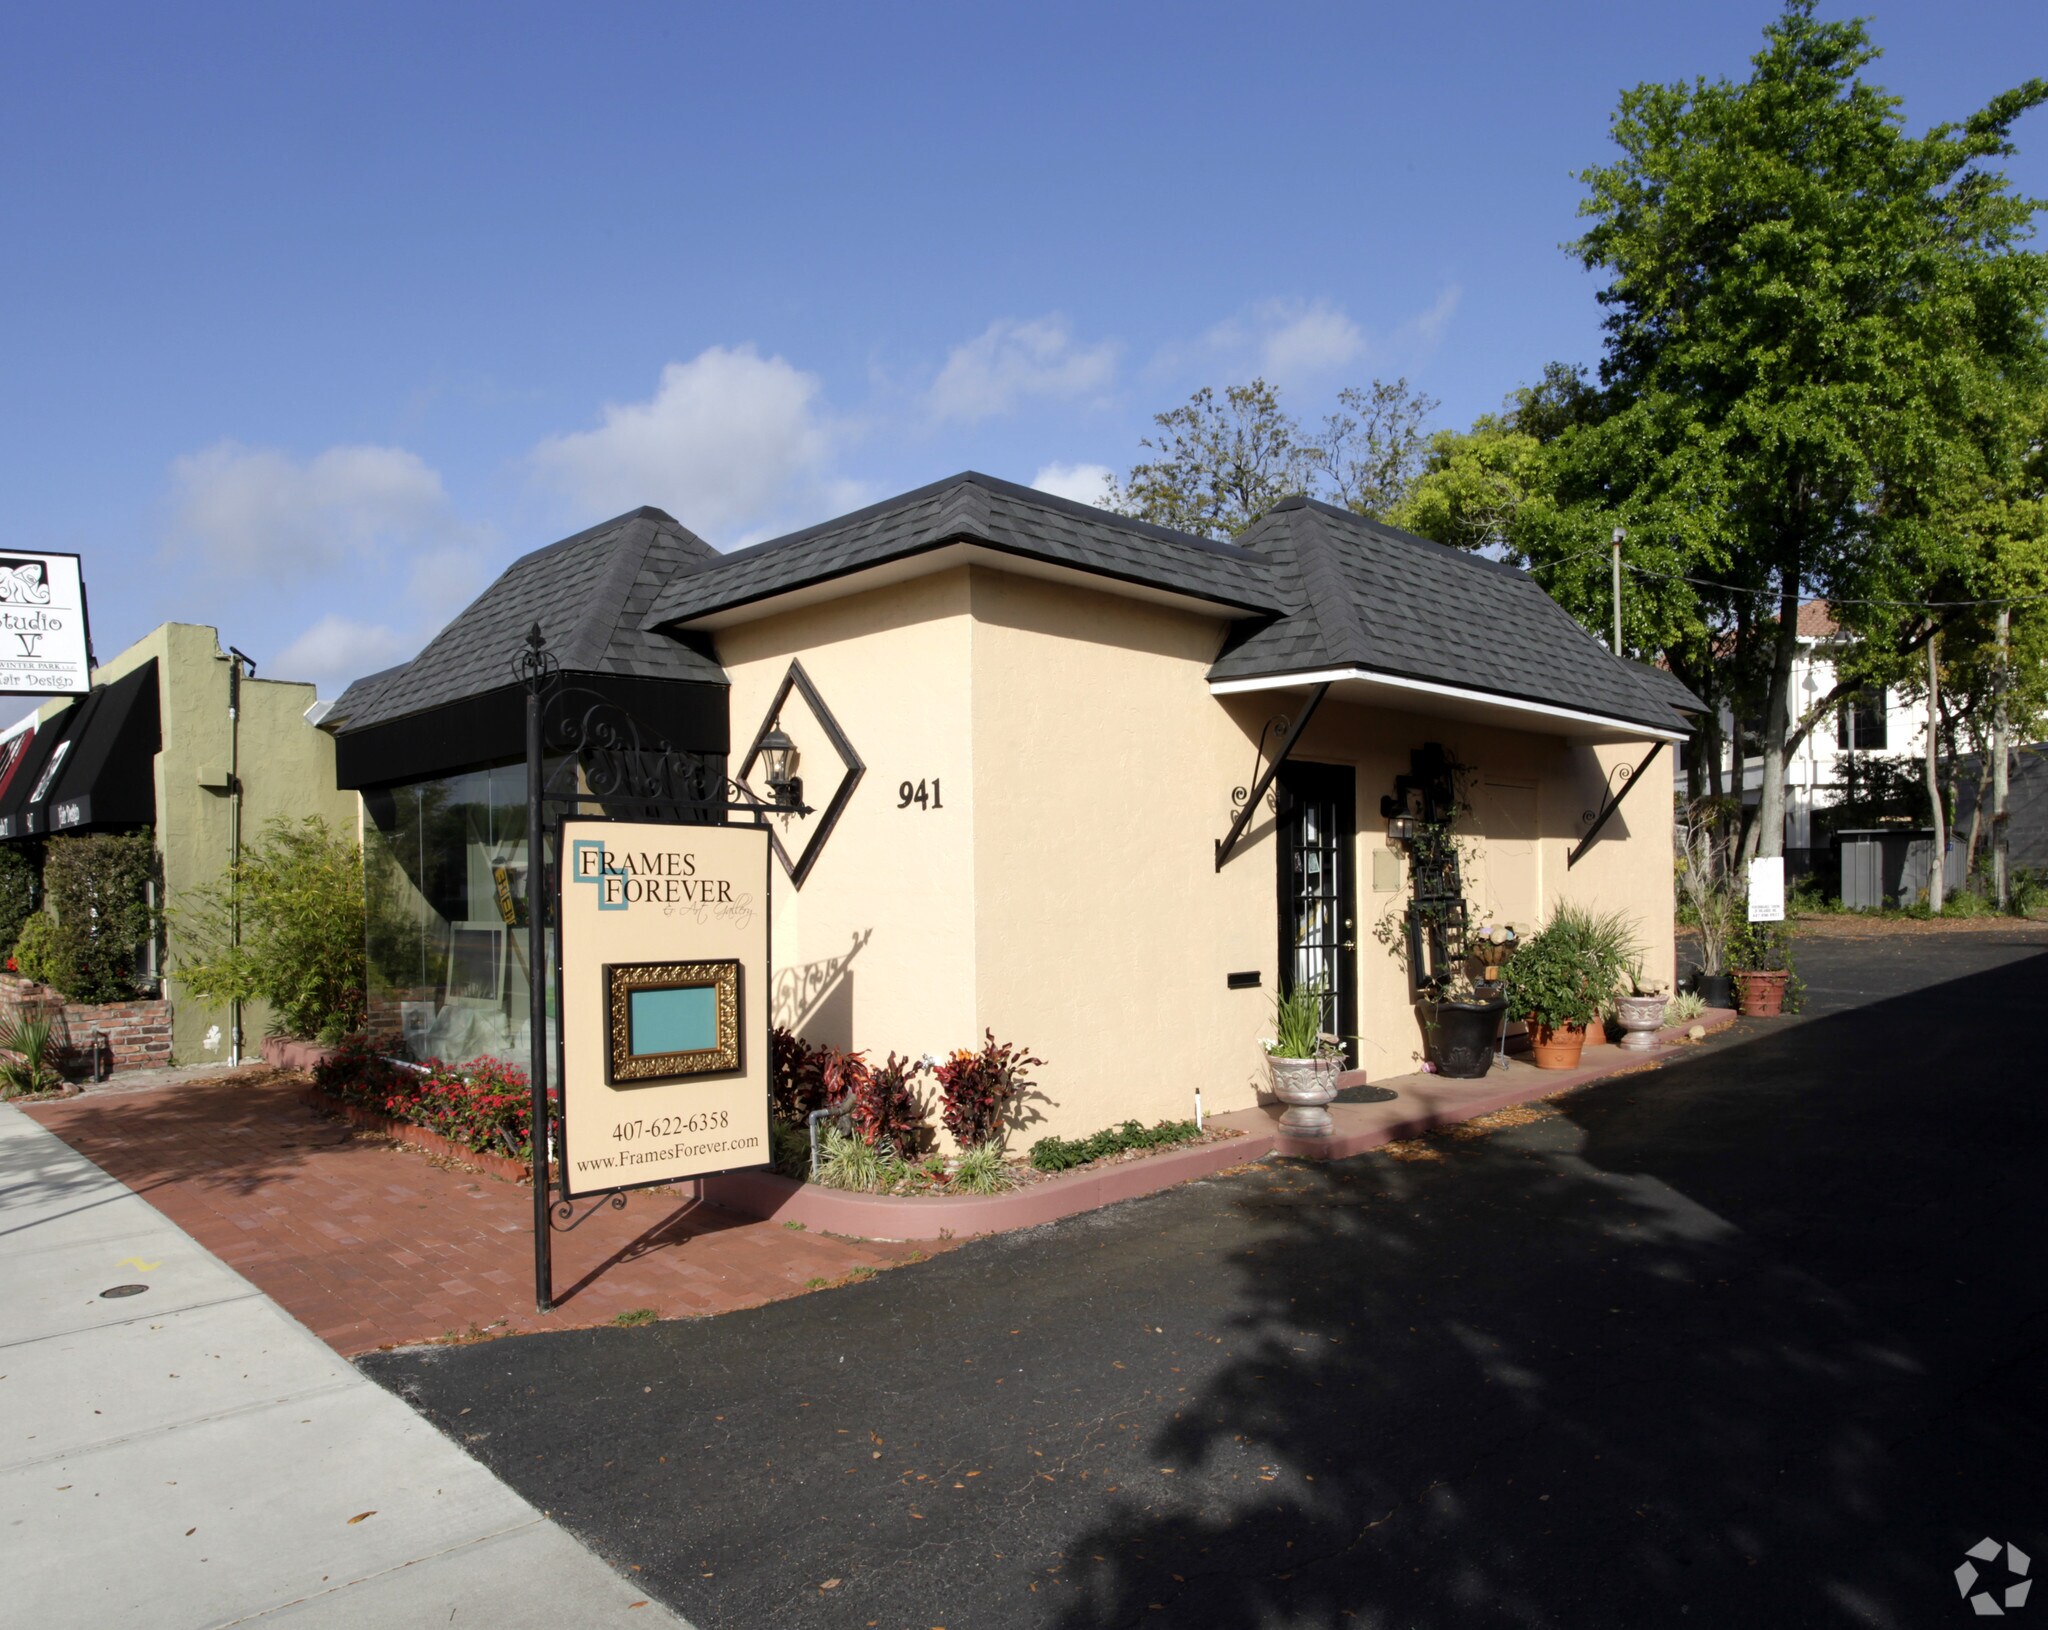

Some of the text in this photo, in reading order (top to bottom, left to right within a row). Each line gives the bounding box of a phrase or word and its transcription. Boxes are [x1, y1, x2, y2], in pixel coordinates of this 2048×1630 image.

[0, 611, 62, 631] tudio
[14, 633, 43, 657] V
[26, 674, 74, 689] Design
[896, 777, 943, 811] 941
[580, 850, 696, 876] FRAMES
[606, 878, 734, 903] FOREVER
[663, 893, 757, 930] & Art Gallery
[612, 1110, 729, 1142] 407-622-6358
[577, 1136, 759, 1172] www.FramesForever.com
